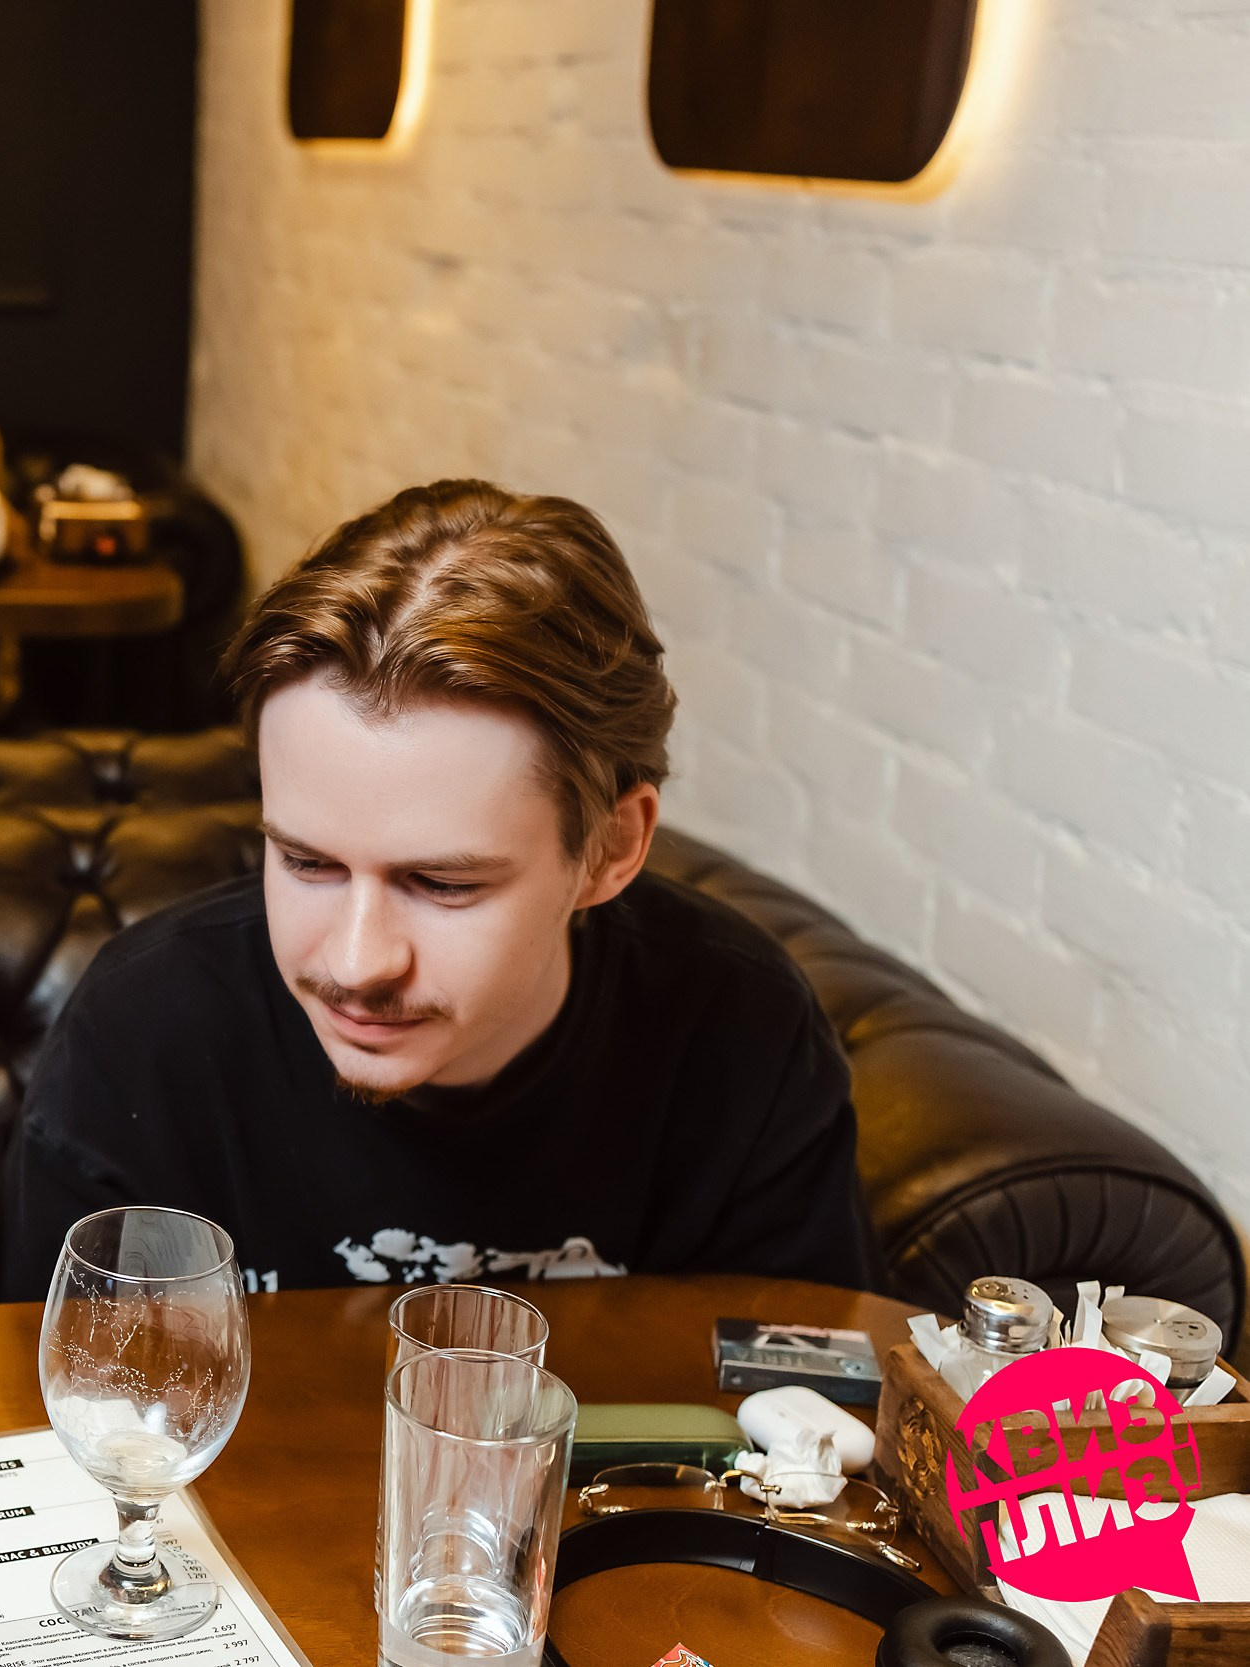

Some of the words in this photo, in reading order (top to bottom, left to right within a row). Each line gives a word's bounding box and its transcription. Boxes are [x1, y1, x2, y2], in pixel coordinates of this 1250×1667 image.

[29, 1548, 40, 1557] &
[44, 1539, 94, 1555] BRANDY
[220, 1623, 237, 1632] 697
[231, 1639, 248, 1648] 997
[242, 1655, 260, 1664] 797
